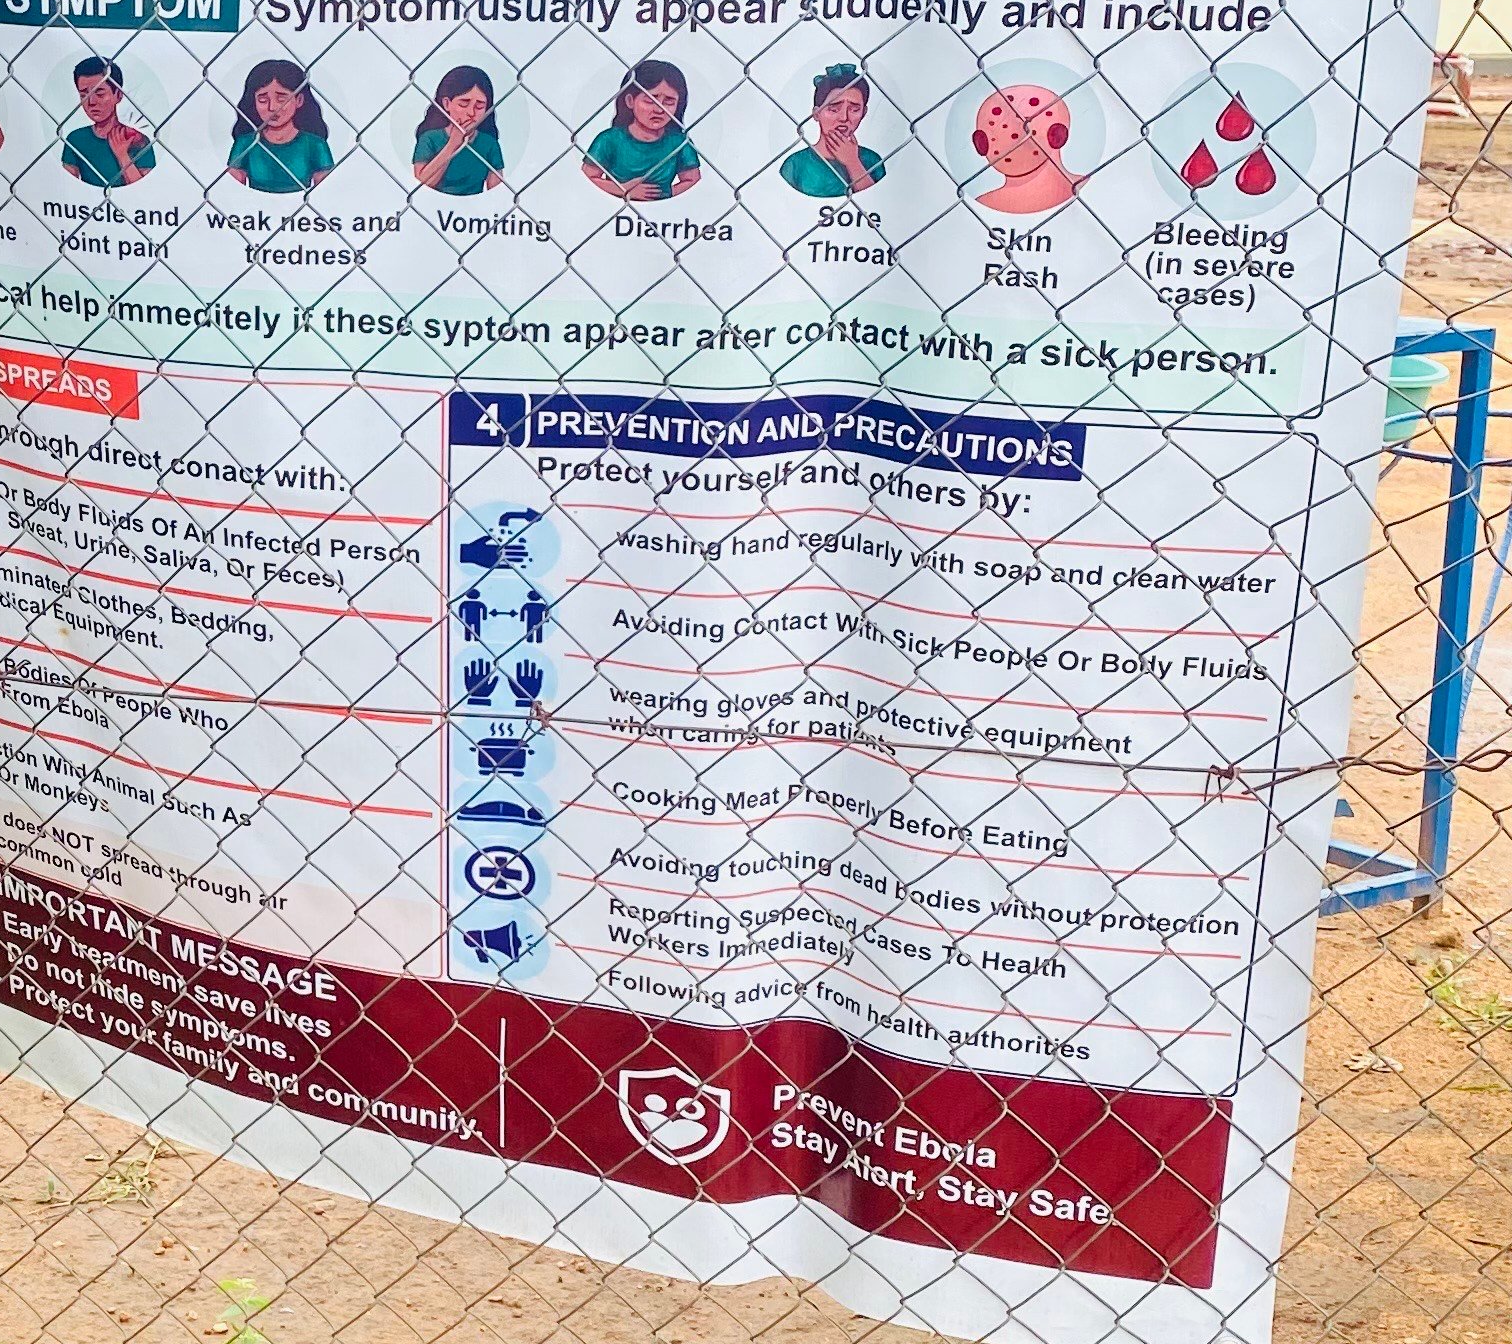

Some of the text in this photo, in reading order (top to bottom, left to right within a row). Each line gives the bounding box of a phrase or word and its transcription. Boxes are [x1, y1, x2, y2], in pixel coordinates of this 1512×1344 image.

[42, 198, 179, 229] muscle and
[206, 210, 402, 234] weak ness and
[437, 211, 551, 239] Vomiting
[614, 216, 733, 243] Diarrhea
[818, 205, 881, 229] Sore
[809, 240, 897, 268] Throat
[986, 227, 1051, 253] Skin
[1153, 222, 1288, 253] Bleeding
[982, 262, 1058, 289] Rash
[1144, 252, 1294, 279] (in severe
[1156, 283, 1256, 312] cases)
[42, 285, 99, 322] help
[293, 308, 313, 334] if
[325, 308, 412, 336] these
[425, 311, 551, 348] syptom
[564, 320, 685, 351] appear
[697, 321, 776, 350] after
[787, 317, 910, 352] contact
[919, 330, 994, 363] with
[1008, 343, 1028, 363] a
[1039, 336, 1117, 367] sick
[1131, 344, 1277, 378] person.
[476, 404, 1073, 465] 4 PREVENTION AND PRECAUTIONS
[87, 442, 162, 472] direct
[170, 458, 265, 486] conact
[274, 466, 349, 492] with:
[538, 457, 1032, 518] Protect yourself and others by:
[24, 487, 71, 521] Body
[79, 505, 144, 533] Fluids
[152, 518, 177, 535] Of
[184, 523, 215, 545] An
[223, 530, 322, 555] Infected
[330, 540, 420, 563] Person
[616, 529, 1275, 596] washing hand regularly with soap and clean water
[610, 848, 1239, 937] Avoiding touching dead bodies without protection
[172, 934, 337, 1001] MESSAGE
[10, 973, 484, 1140] Protect your family and community.
[773, 1083, 997, 1169] Prevent Ebola
[771, 1123, 838, 1163] Stay
[937, 1176, 1017, 1215] Stay
